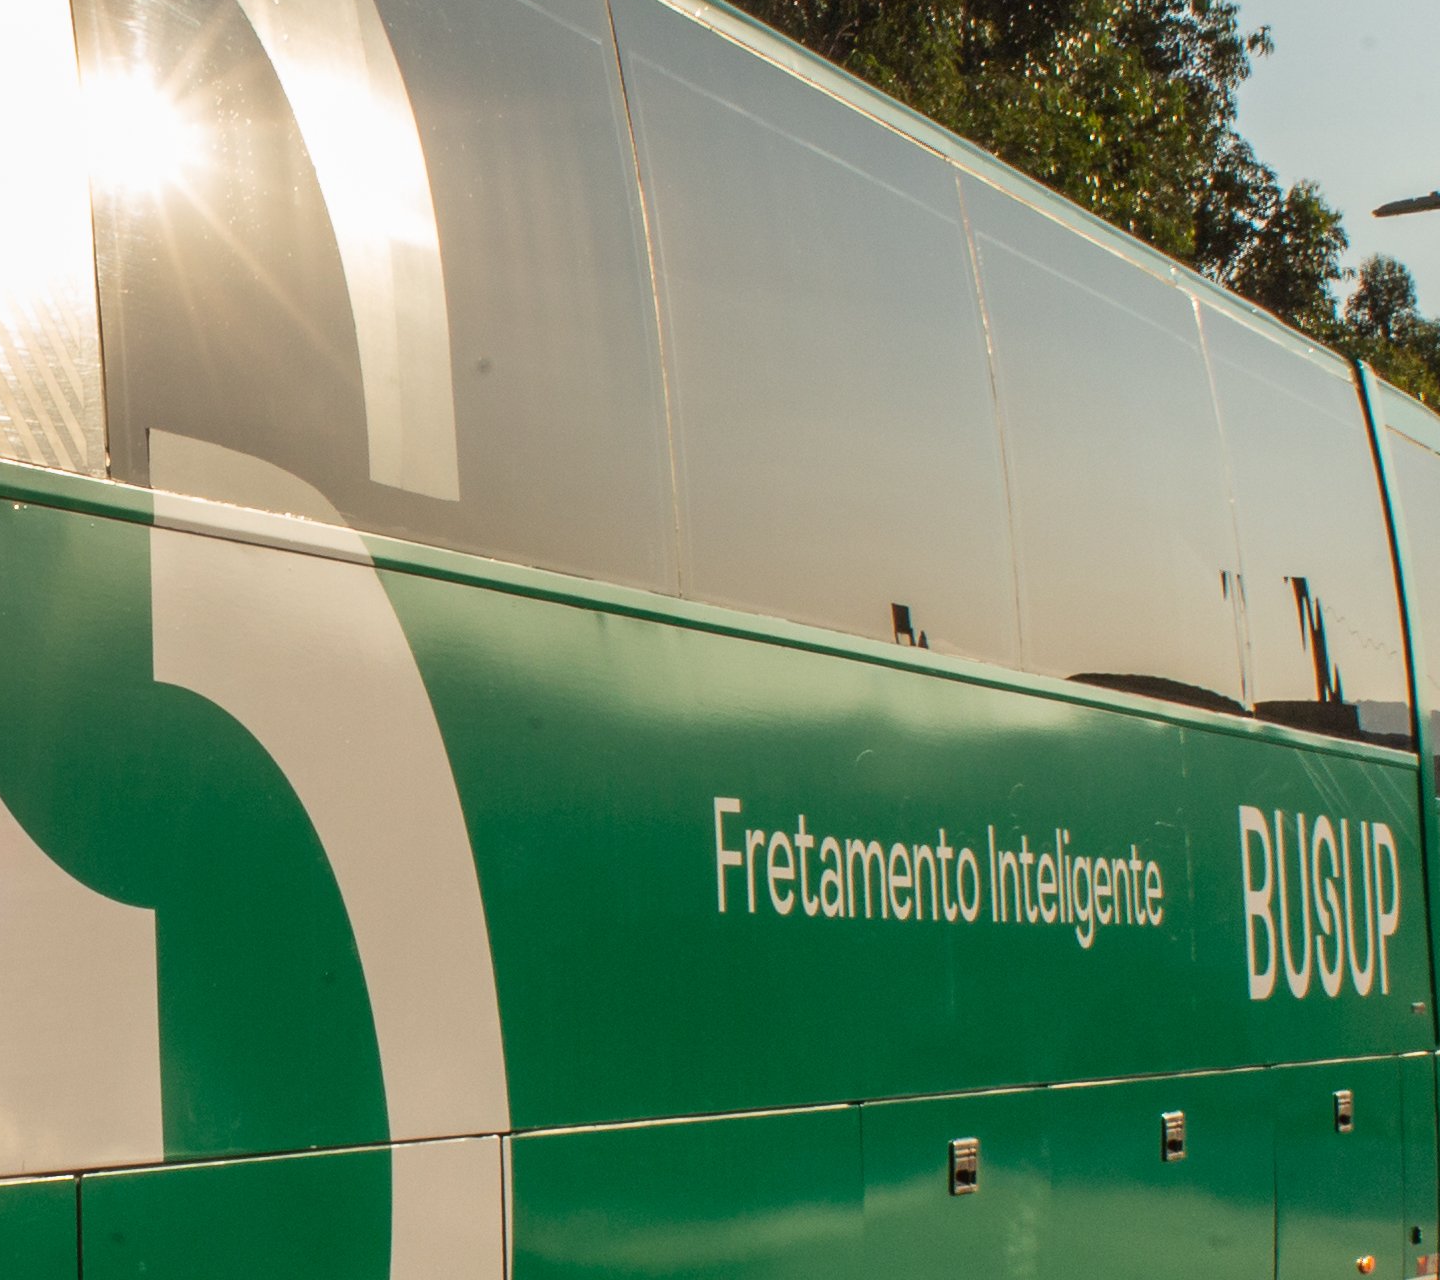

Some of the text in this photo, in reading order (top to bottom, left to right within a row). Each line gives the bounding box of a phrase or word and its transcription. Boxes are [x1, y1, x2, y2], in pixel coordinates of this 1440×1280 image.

[714, 797, 1163, 949] Fretamento Inteligente
[1239, 805, 1400, 1000] BUSUP
